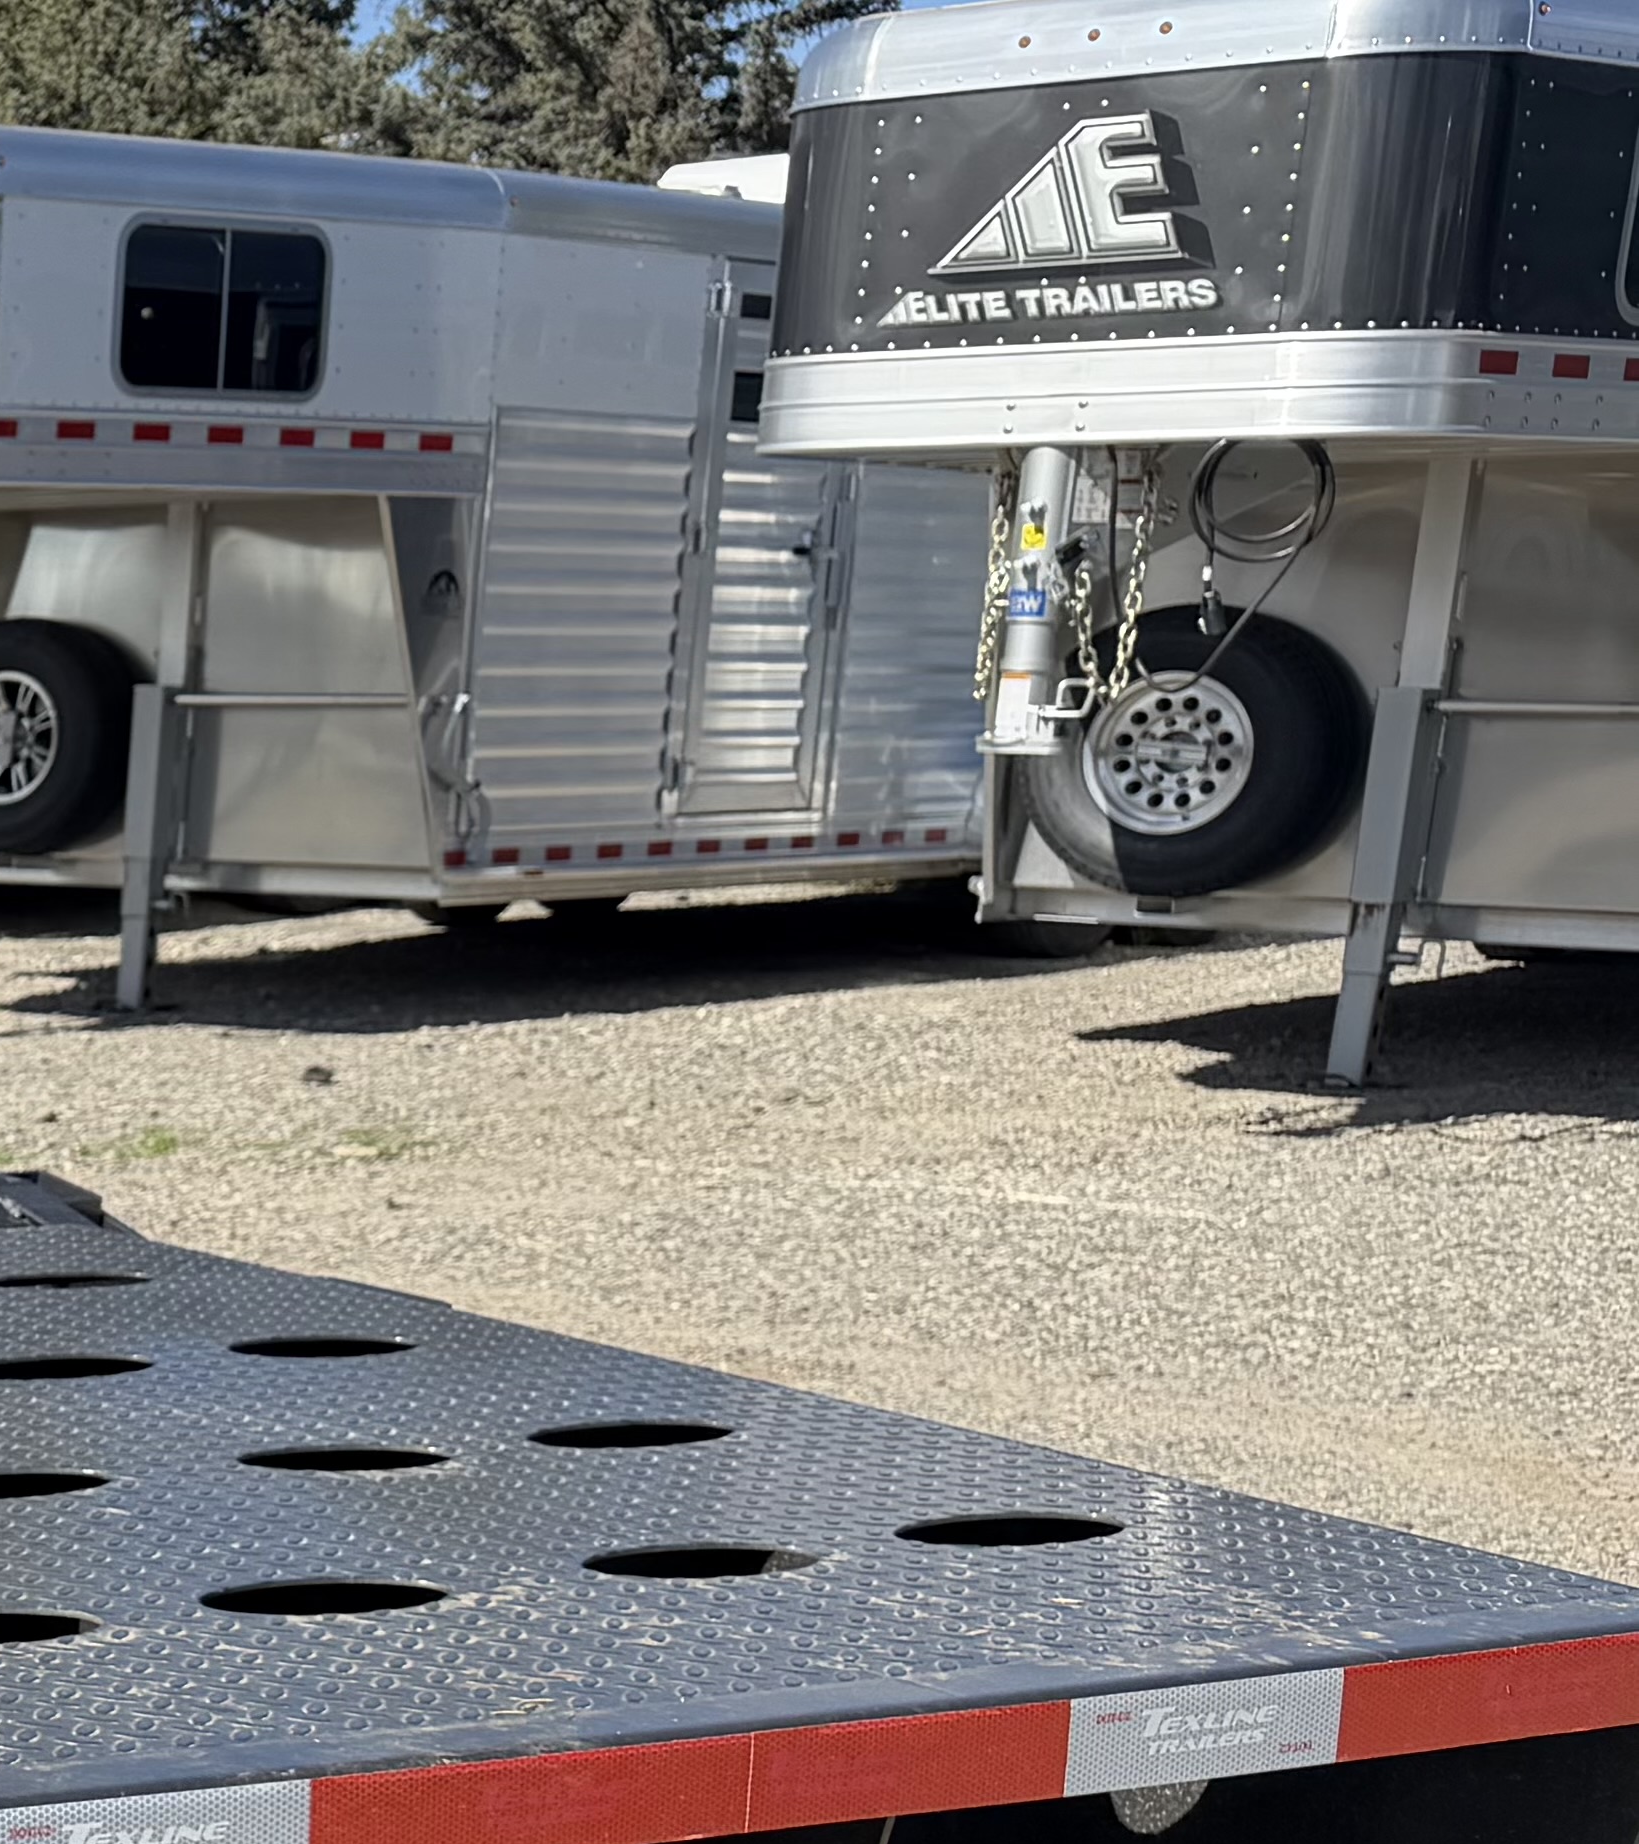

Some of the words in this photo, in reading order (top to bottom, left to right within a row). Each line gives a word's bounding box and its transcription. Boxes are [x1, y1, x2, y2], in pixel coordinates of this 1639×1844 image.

[877, 291, 1010, 328] ELITE
[1016, 279, 1219, 319] TRAILERS
[1147, 1728, 1267, 1756] TRAILERS
